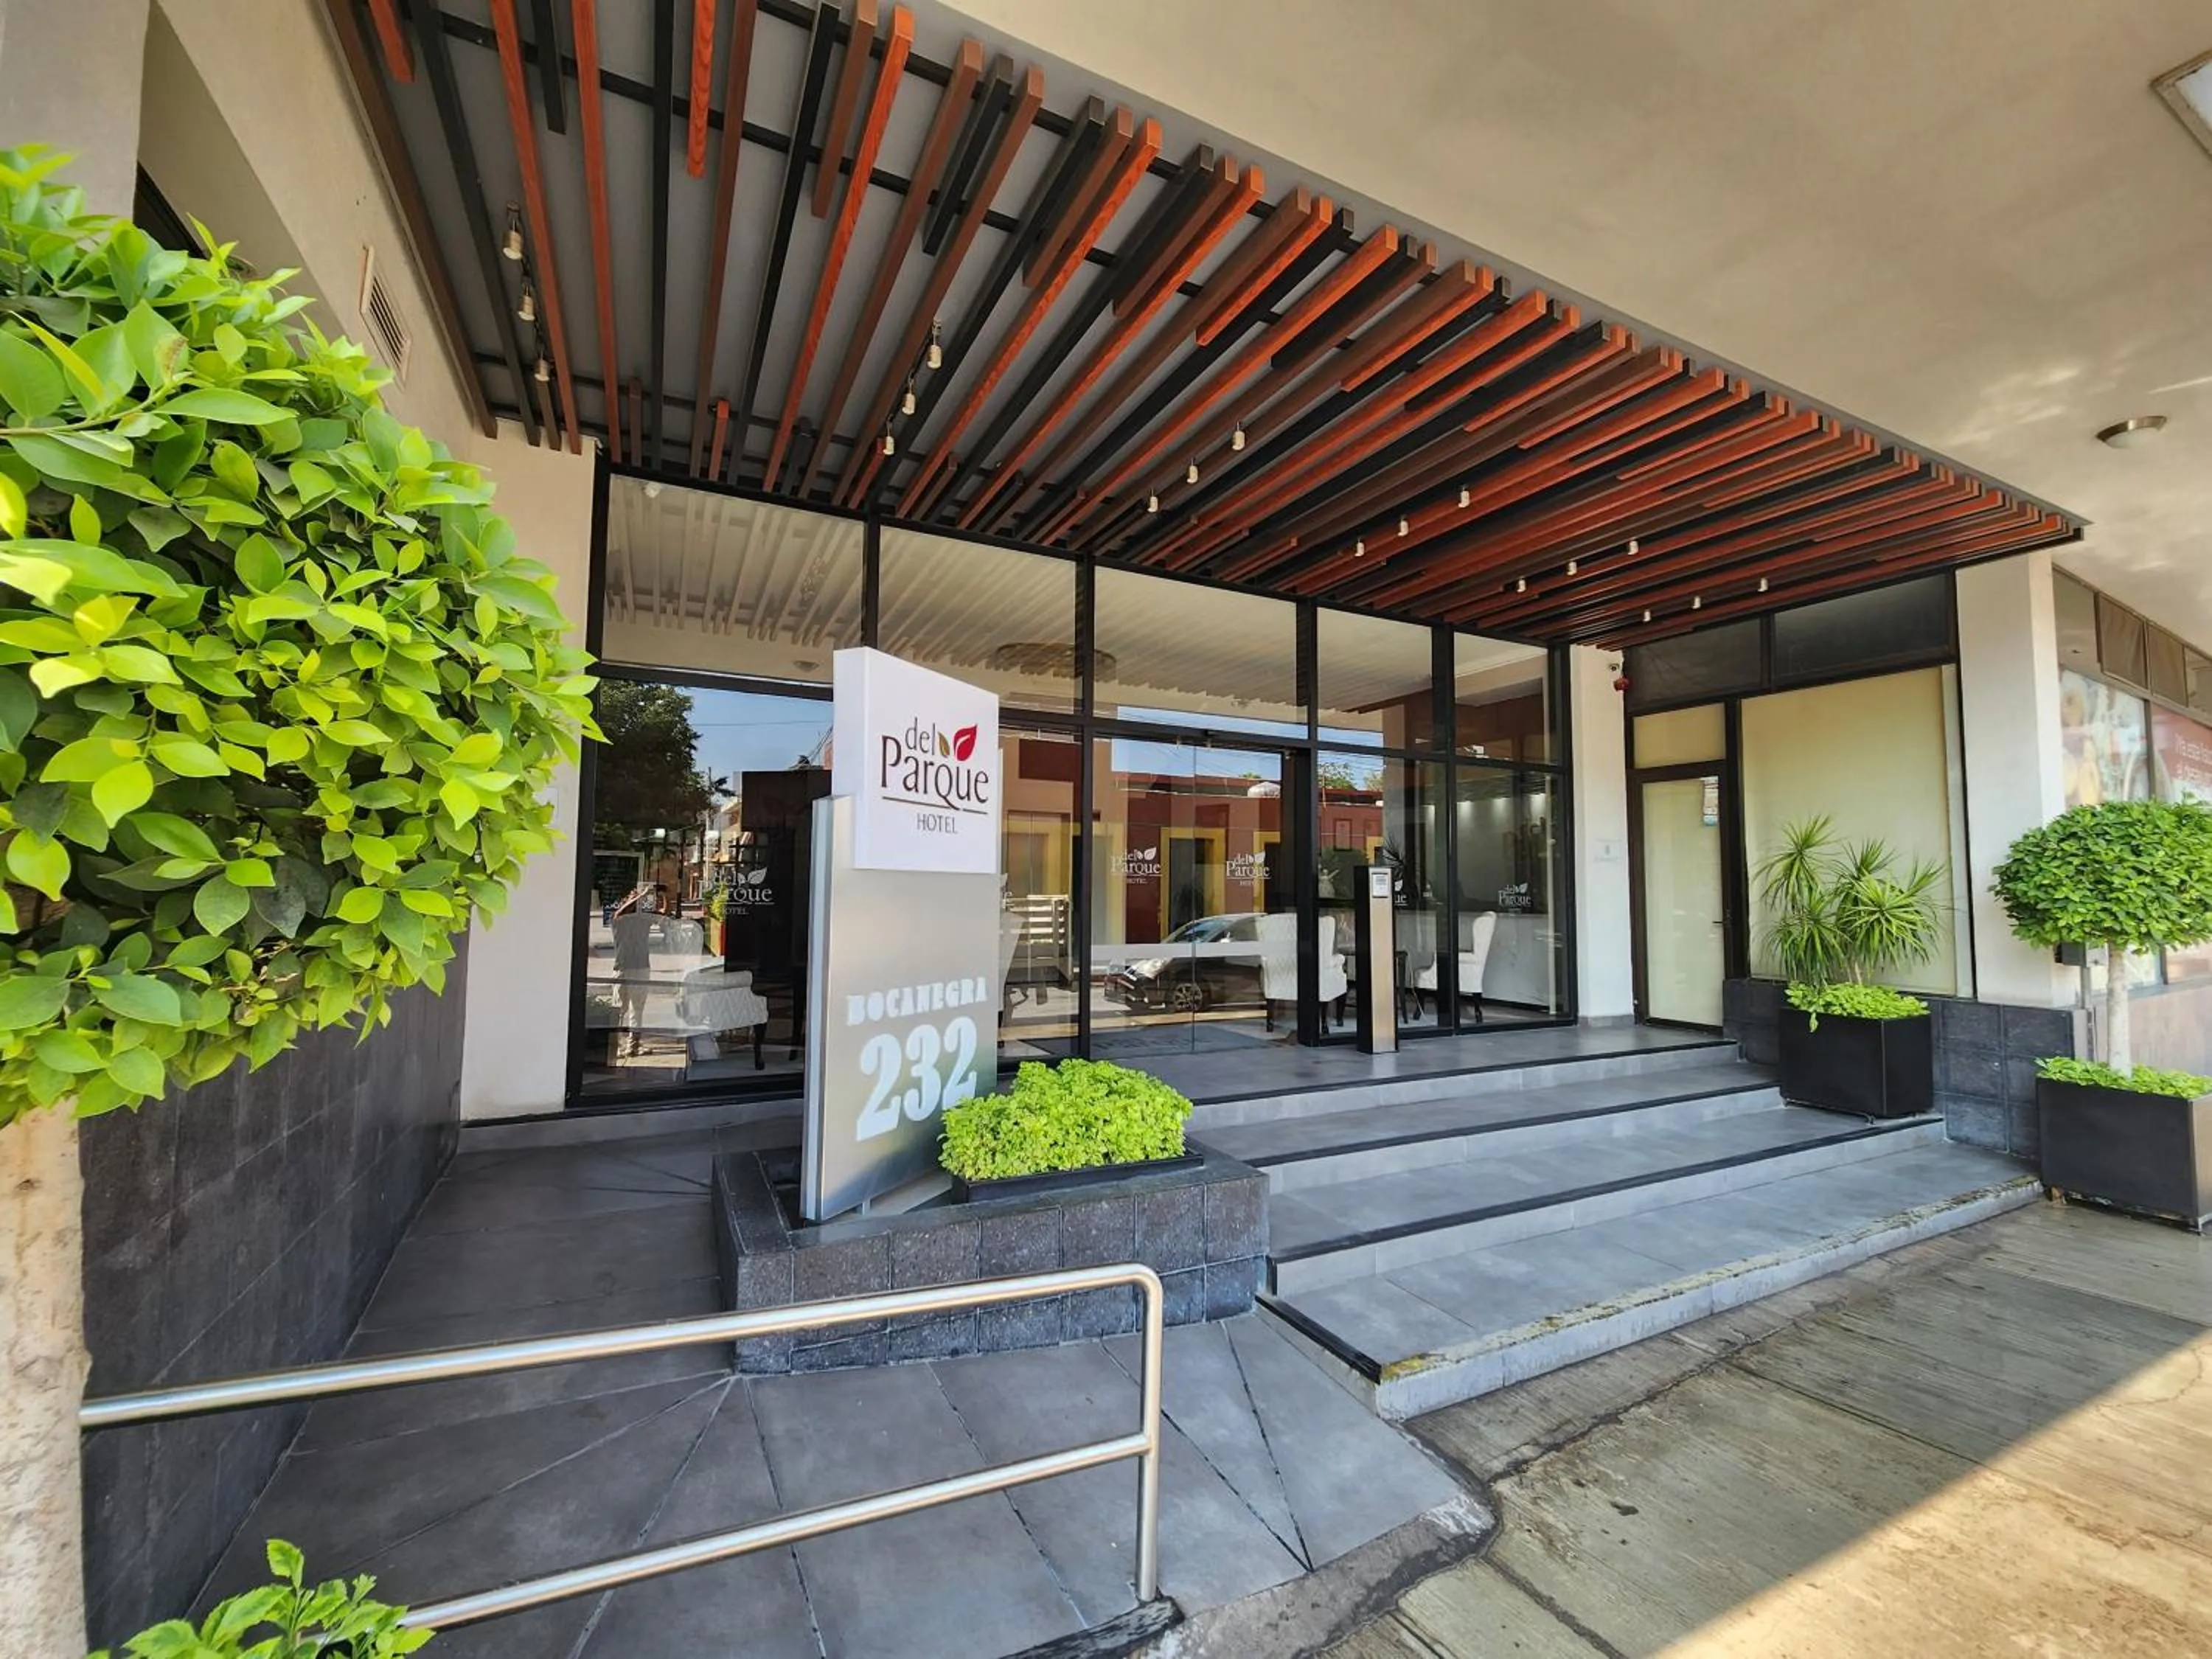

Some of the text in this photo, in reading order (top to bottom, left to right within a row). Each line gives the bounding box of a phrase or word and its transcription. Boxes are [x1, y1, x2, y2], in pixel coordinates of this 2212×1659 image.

[905, 717, 936, 756] del
[917, 813, 958, 834] HOTEL
[1234, 853, 1248, 865] del
[847, 977, 988, 1026] BOCANEGRA
[857, 1016, 978, 1142] 232
